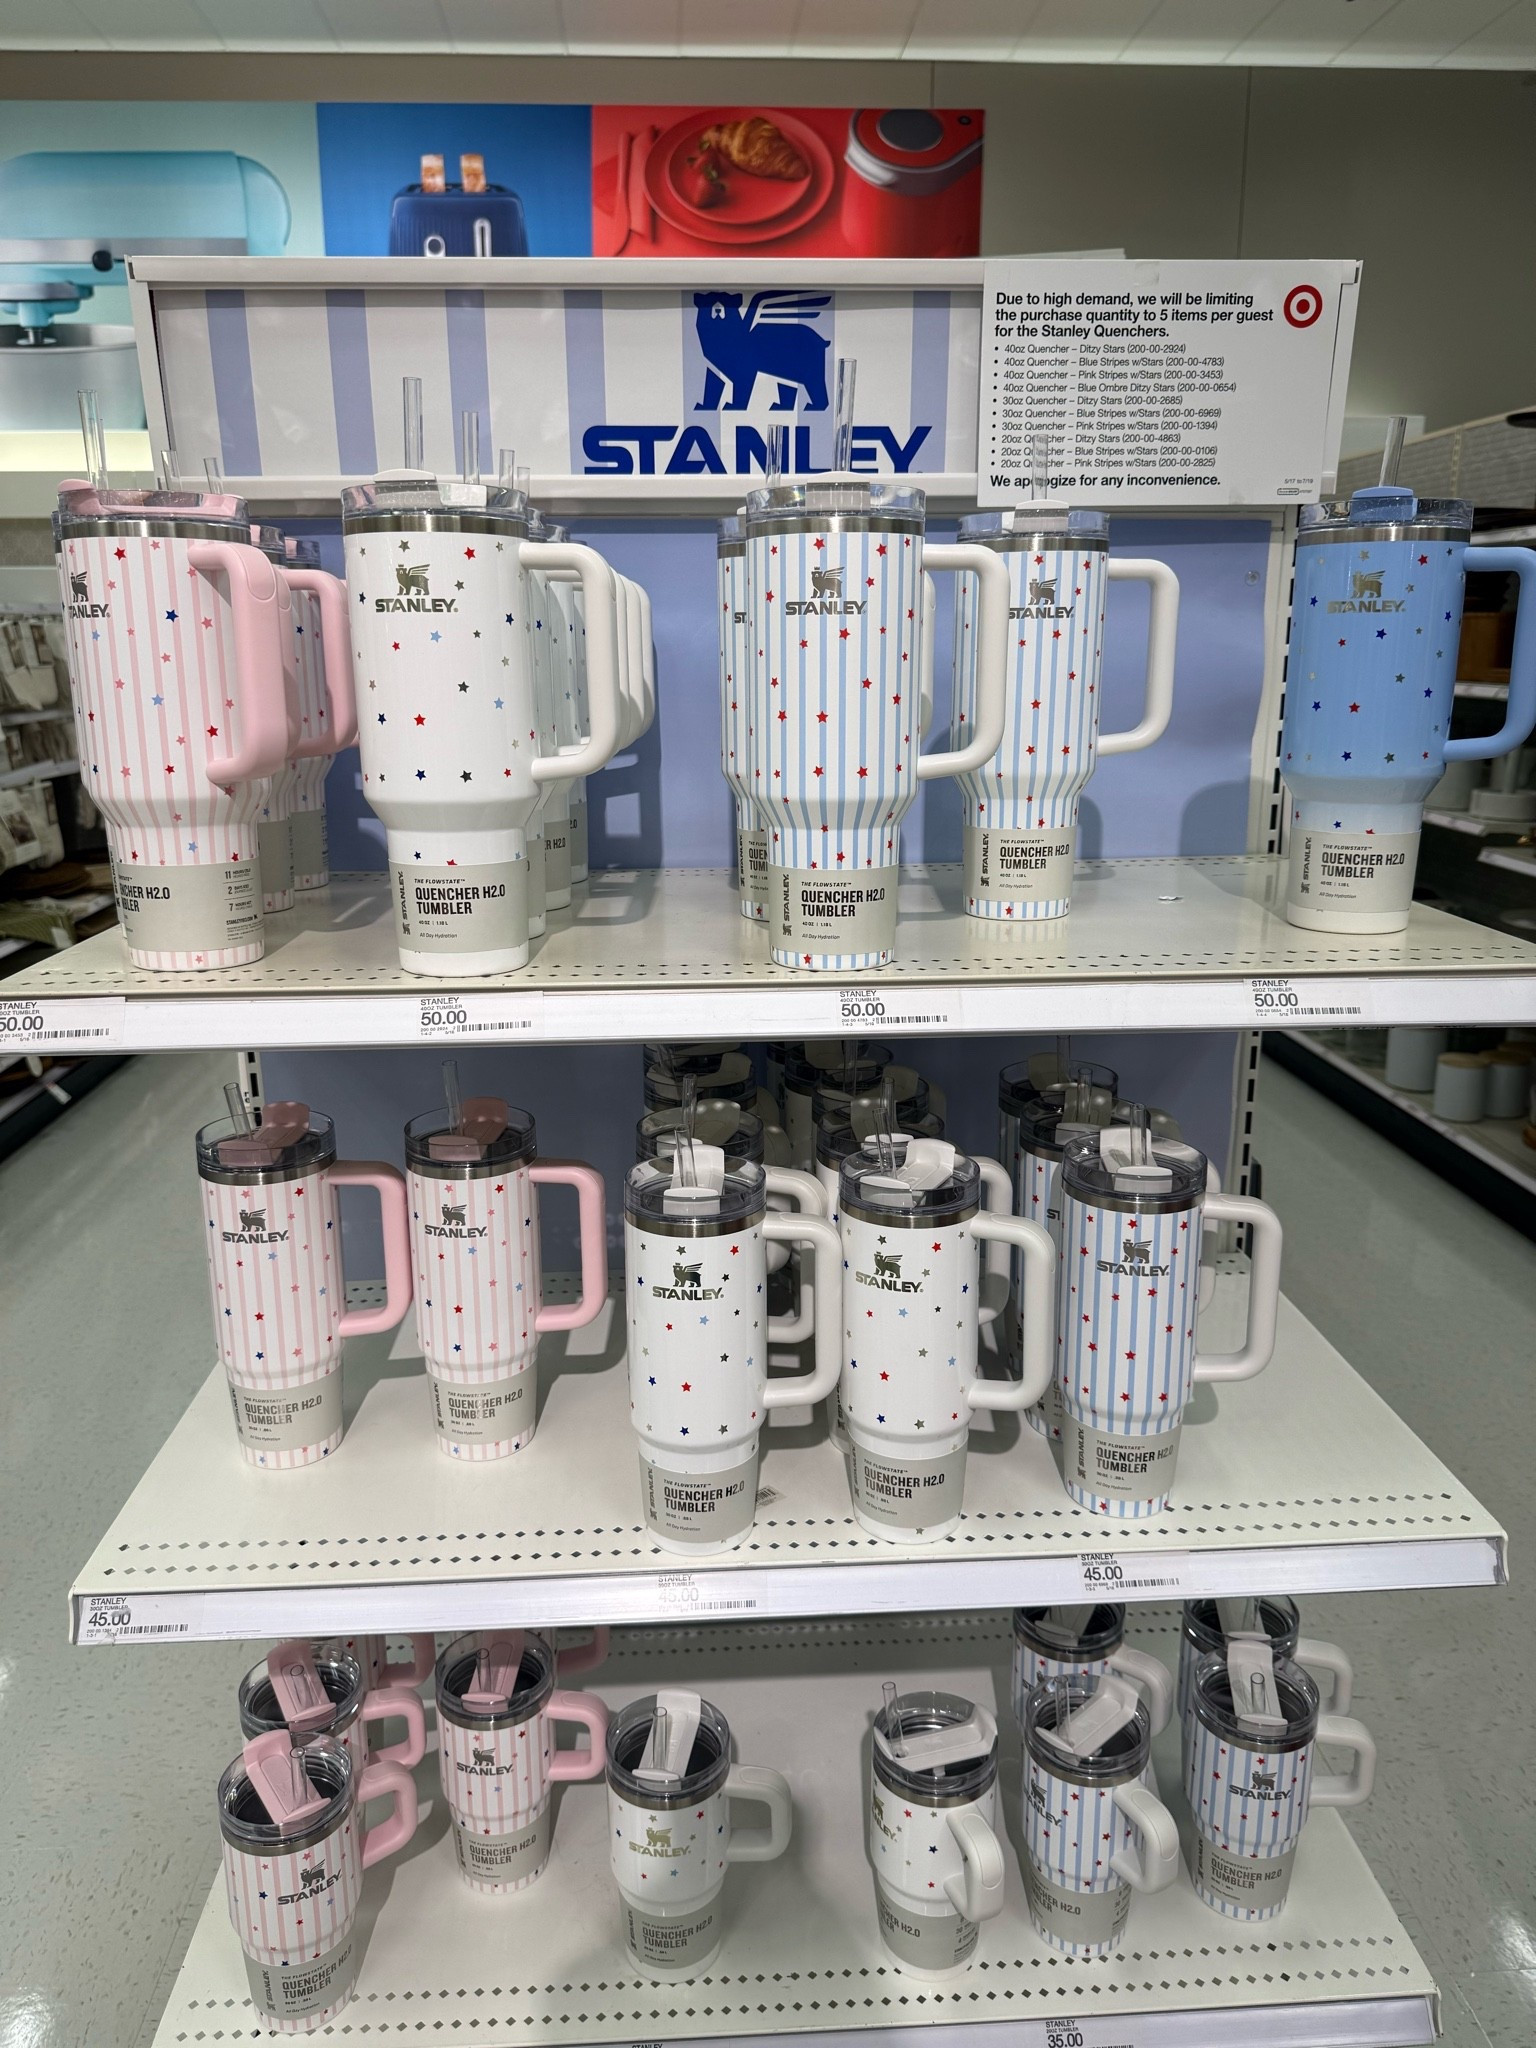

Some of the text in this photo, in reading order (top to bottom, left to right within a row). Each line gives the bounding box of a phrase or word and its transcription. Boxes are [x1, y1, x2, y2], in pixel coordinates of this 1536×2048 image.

[996, 292, 1253, 309] Due to high demand, we will be limiting
[995, 308, 1274, 325] the purchase quantity to 5 items per guest
[995, 325, 1169, 341] for the Stanley Quenchers.
[1005, 344, 1186, 355] 40oz Quencher Ditzy Stars (200-00-2924)
[1004, 357, 1224, 368] 40oz Quencher Blue Stripes w/Stars (200-00-4783)
[1004, 370, 1223, 381] 40oz Quencher Pink Stripes w/Stars (200-00-3453)
[1003, 383, 1236, 394] 40oz Quencher Blue Ombre Ditzy Stars (200-00-0654)
[1003, 396, 1183, 407] 30oz Quencher Ditzy Stars (200-00-2685)
[1002, 409, 1221, 419] 30oz Quencher Blue Stripes w/Stars (200-00-6969)
[1002, 421, 1218, 432] 30oz Quencher Pink Stripes w/Stars (200-00-1394)
[1002, 434, 1181, 445] 20oz Ditzy Stars (200-00-4863)
[582, 425, 933, 474] STANLEY
[1001, 446, 1217, 457] 20oz Blue Stripes w/Stars (200-00-0106)
[1001, 458, 1216, 469] 20oz Pink Stripes w/Stars (200-00-2825)
[990, 474, 1220, 488] We for any inconvenience.
[375, 598, 455, 614] STANLEY
[785, 601, 864, 616] STANLEY
[1327, 599, 1404, 614] STANLEY
[1000, 844, 1069, 858] QUENCHER H2.0
[1000, 859, 1046, 869] TUMBLER
[1322, 852, 1405, 866] QUENCHER H2.0
[1321, 865, 1374, 878] TUMBLER
[415, 884, 505, 901] QUENCHER H2.0
[801, 888, 885, 903] QUENCHER H2.0
[416, 902, 472, 914] TUMBLER
[801, 904, 856, 917] TUMBLER
[420, 997, 459, 1006] STANLEY
[1254, 993, 1298, 1007] 50.00
[841, 1003, 885, 1016] 50.00
[421, 1010, 467, 1026] 50.00
[222, 1230, 288, 1243] STANLEY
[425, 1225, 487, 1238] STANLEY
[1097, 1260, 1169, 1277] STANLEY
[855, 1271, 922, 1293] STANLEY
[652, 1286, 722, 1301] STANLEY
[504, 1388, 523, 1404] H2.0
[245, 1395, 322, 1415] QUENCHER H2.0
[246, 1412, 292, 1425] TUMBLER
[1096, 1444, 1173, 1462] QUENCHER H2.0
[1096, 1457, 1147, 1473] TUMBLER
[864, 1466, 945, 1487] QUENCHER H2.0
[664, 1486, 723, 1501] QUENCHER
[725, 1480, 745, 1497] H2.0
[864, 1477, 912, 1499] TUMBLER
[664, 1498, 715, 1512] TUMBLER
[1081, 1553, 1114, 1561] STANLEY
[658, 1574, 692, 1582] STANLEY
[1084, 1566, 1123, 1581] 45.00
[91, 1597, 126, 1606] STANLEY
[659, 1588, 699, 1602] 45.00
[89, 1612, 131, 1627] 45.00
[456, 1762, 513, 1776] STANLEY
[1229, 1784, 1291, 1800] STANLEY
[470, 1845, 517, 1857] QUENCHER
[629, 1841, 690, 1858] STANLEY
[470, 1852, 512, 1865] TUMBLER
[1211, 1858, 1282, 1881] QUENCHER H2.0
[1211, 1866, 1255, 1889] TUMBLER
[278, 1869, 341, 1905] STANLEY
[642, 1928, 694, 1940] QUENCHER
[642, 1935, 687, 1948] TUMBLER
[282, 1963, 337, 1990] QUENCHER
[283, 1977, 331, 1999] TUMBLER
[1045, 2020, 1075, 2028] STANLEY
[1048, 2033, 1083, 2048] 35.00
